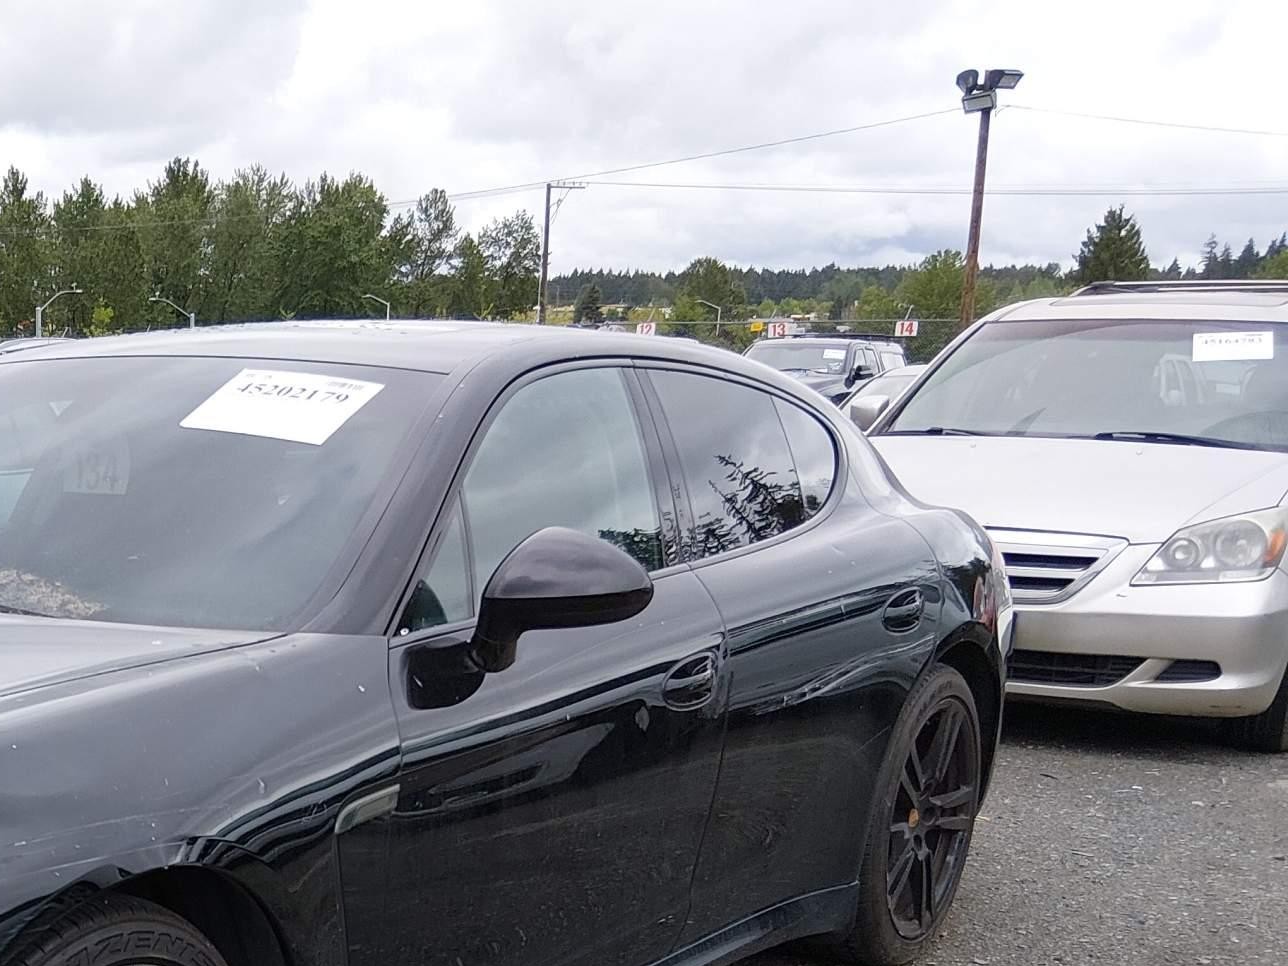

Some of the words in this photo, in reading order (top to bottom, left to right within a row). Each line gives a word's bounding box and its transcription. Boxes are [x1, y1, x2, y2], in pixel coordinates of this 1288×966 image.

[772, 323, 785, 336] 13
[900, 322, 914, 335] 14
[237, 382, 350, 403] 45202179
